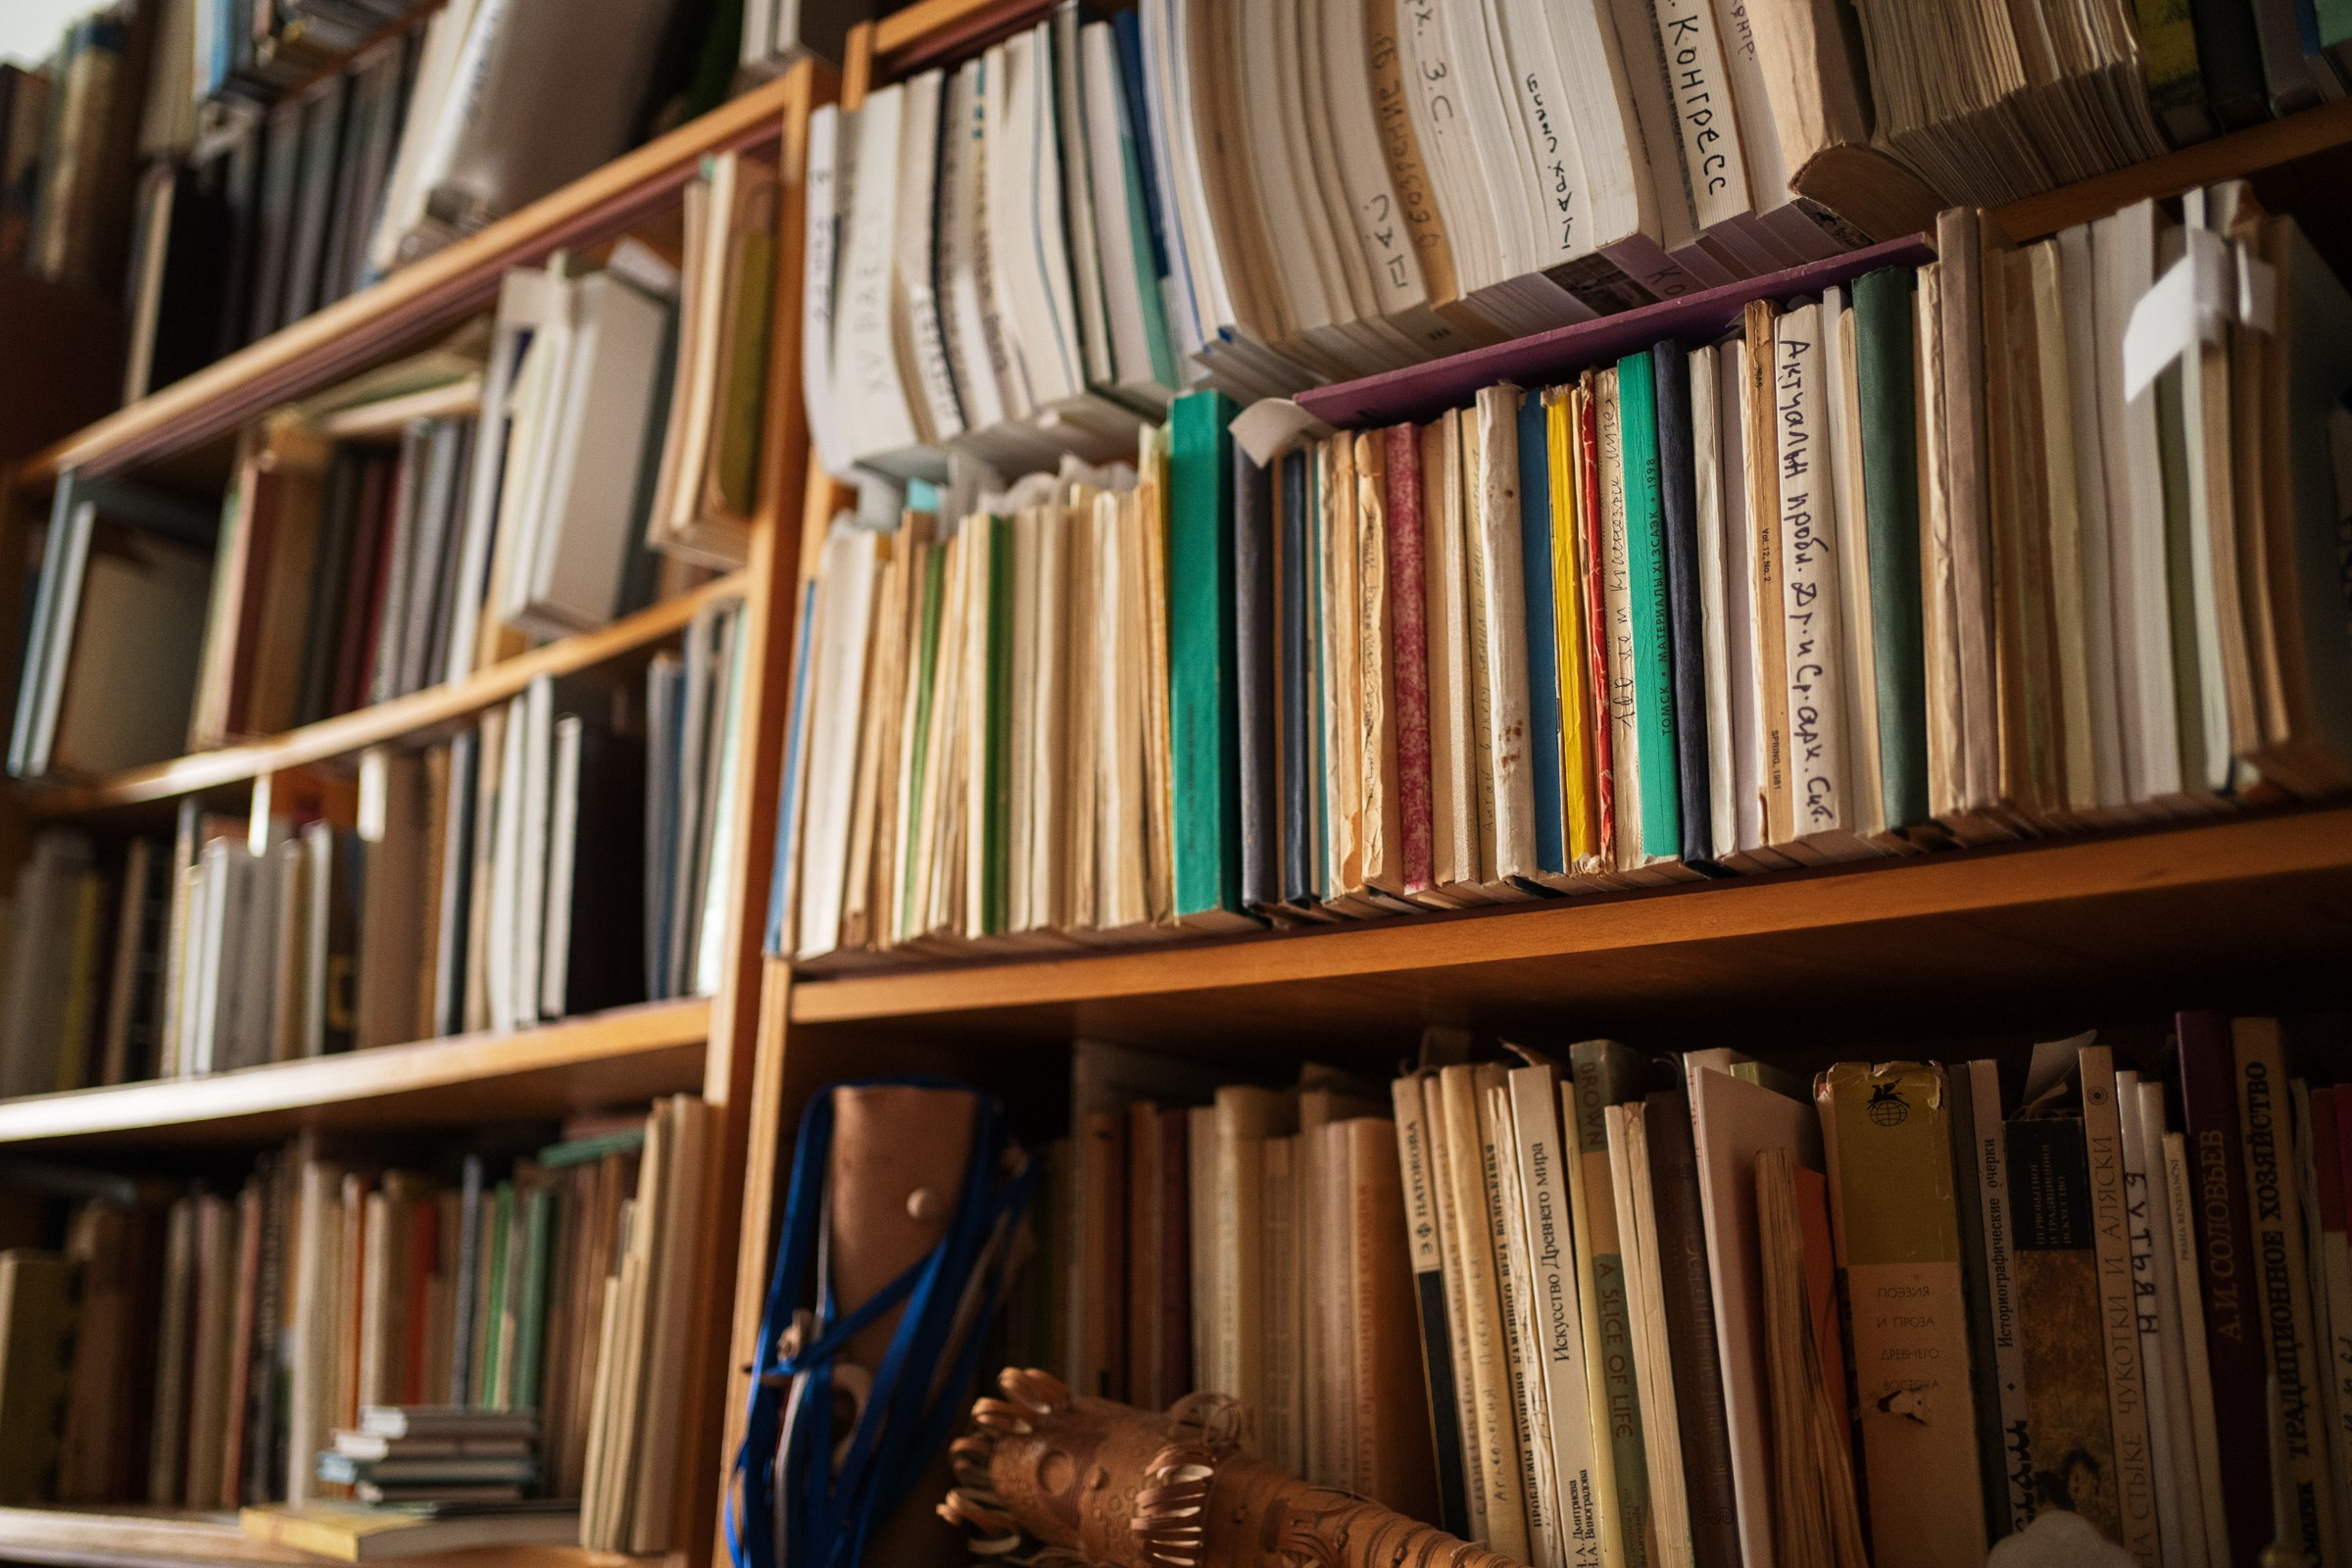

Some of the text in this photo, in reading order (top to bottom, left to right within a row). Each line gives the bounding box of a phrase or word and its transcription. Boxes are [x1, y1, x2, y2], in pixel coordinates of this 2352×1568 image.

[1668, 15, 1728, 197] Конгресс
[1645, 457, 1658, 490] 1998
[1761, 527, 1770, 545] Vol.
[1762, 547, 1771, 561] 12,
[1652, 576, 1670, 664] МАТЕРИАЛЫ
[1659, 686, 1673, 737] ТОМСК
[1772, 729, 1782, 768] SPRING,
[1529, 1141, 1551, 1187] мира
[1985, 1137, 2002, 1190] очерки
[2244, 1060, 2281, 1222] ХОЗЯЙСТВО
[2091, 1136, 2122, 1241] АЛЯСКИ
[2199, 1128, 2236, 1278] СОЛОВЬЕВ
[1536, 1190, 1562, 1271] Древнего
[1578, 1061, 1635, 1440] BROWN A SLICE OF LIFE
[1877, 1286, 1930, 1299] ПОЭЗИЯ
[1985, 1198, 2015, 1348] Историографические
[2102, 1257, 2124, 1276] И
[1546, 1272, 1572, 1363] Искусство
[1877, 1315, 1936, 1329] И ПРОЗА
[2266, 1230, 2309, 1460] ТРАДИЦИОННОЕ
[1880, 1347, 1939, 1360] ДРЕВНЕГО
[2107, 1295, 2137, 1416] ЧУКОТКИ
[1567, 1479, 1586, 1542] Дмитриева
[1577, 1469, 1596, 1540] Виноградова
[2122, 1434, 2148, 1521] СТЫКЕ
